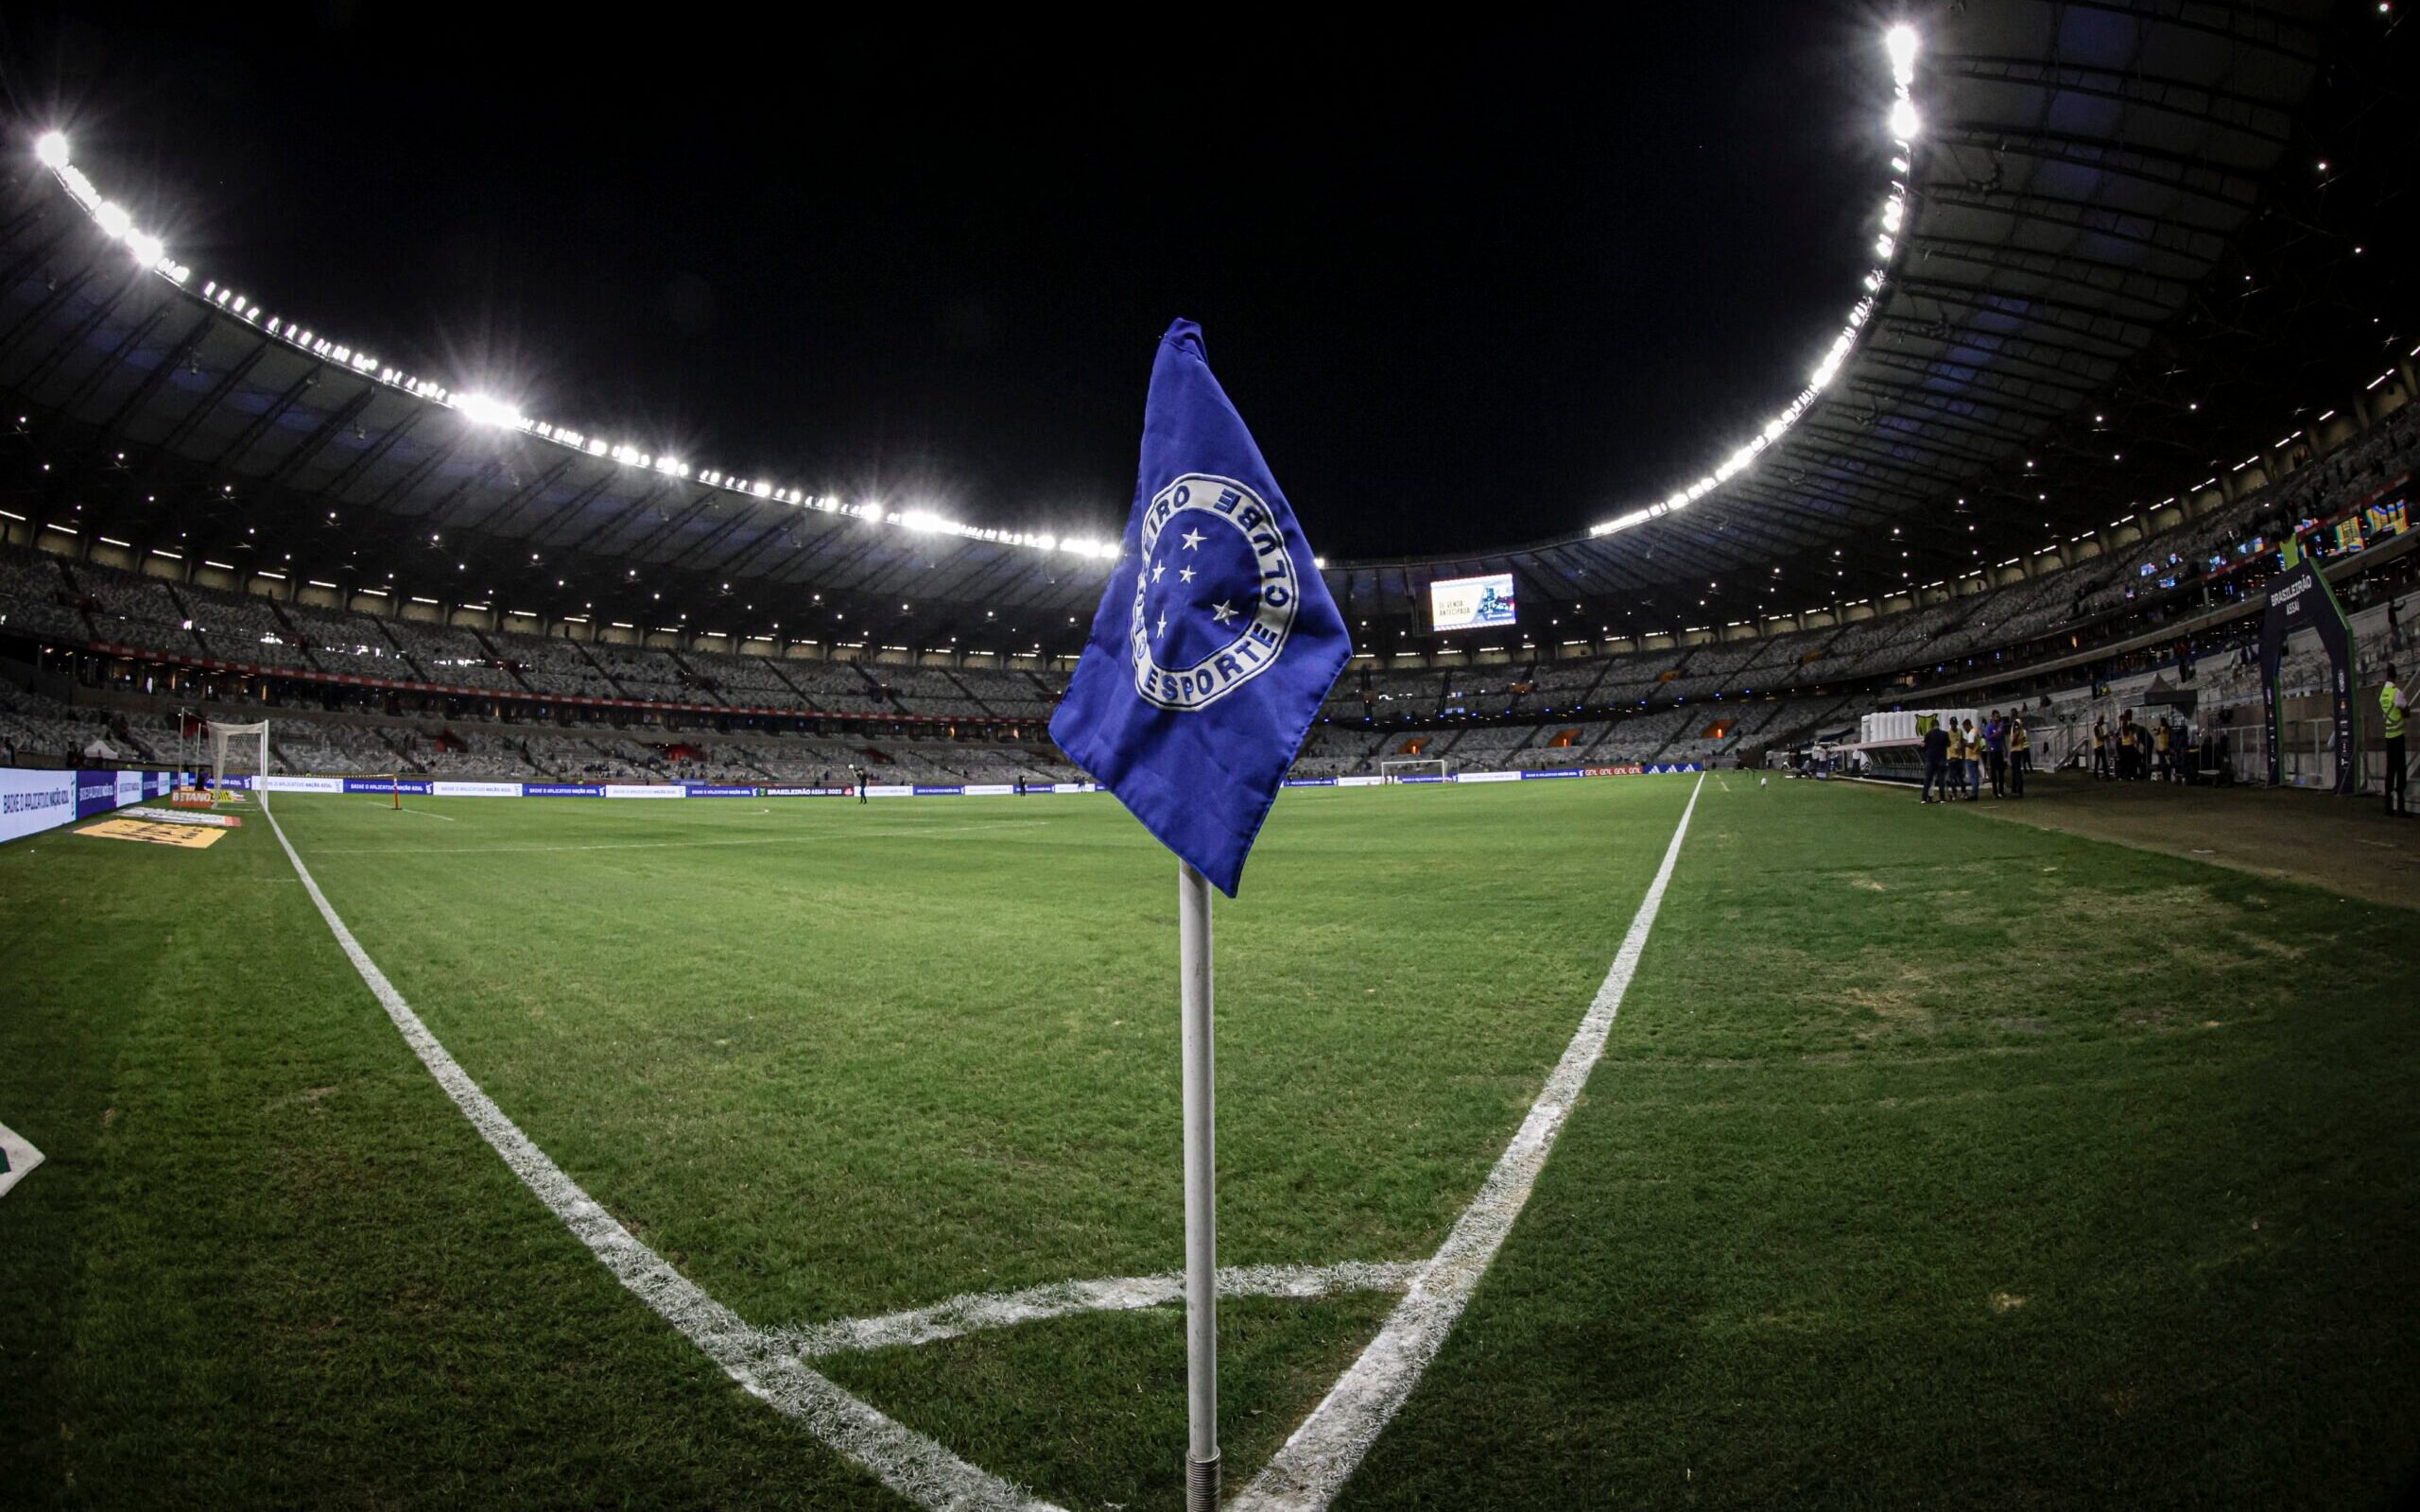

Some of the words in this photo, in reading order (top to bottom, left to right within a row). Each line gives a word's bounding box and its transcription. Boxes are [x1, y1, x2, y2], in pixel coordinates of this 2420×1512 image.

[1213, 488, 1289, 608] CLUBE
[1135, 485, 1191, 659] CREIRO
[2271, 574, 2312, 607] BRASILEIRÃO
[1145, 623, 1278, 702] ESPORTE
[4, 793, 19, 814] BAIXE
[172, 792, 211, 802] BETANO
[767, 787, 810, 796] BRASILEIRÃO
